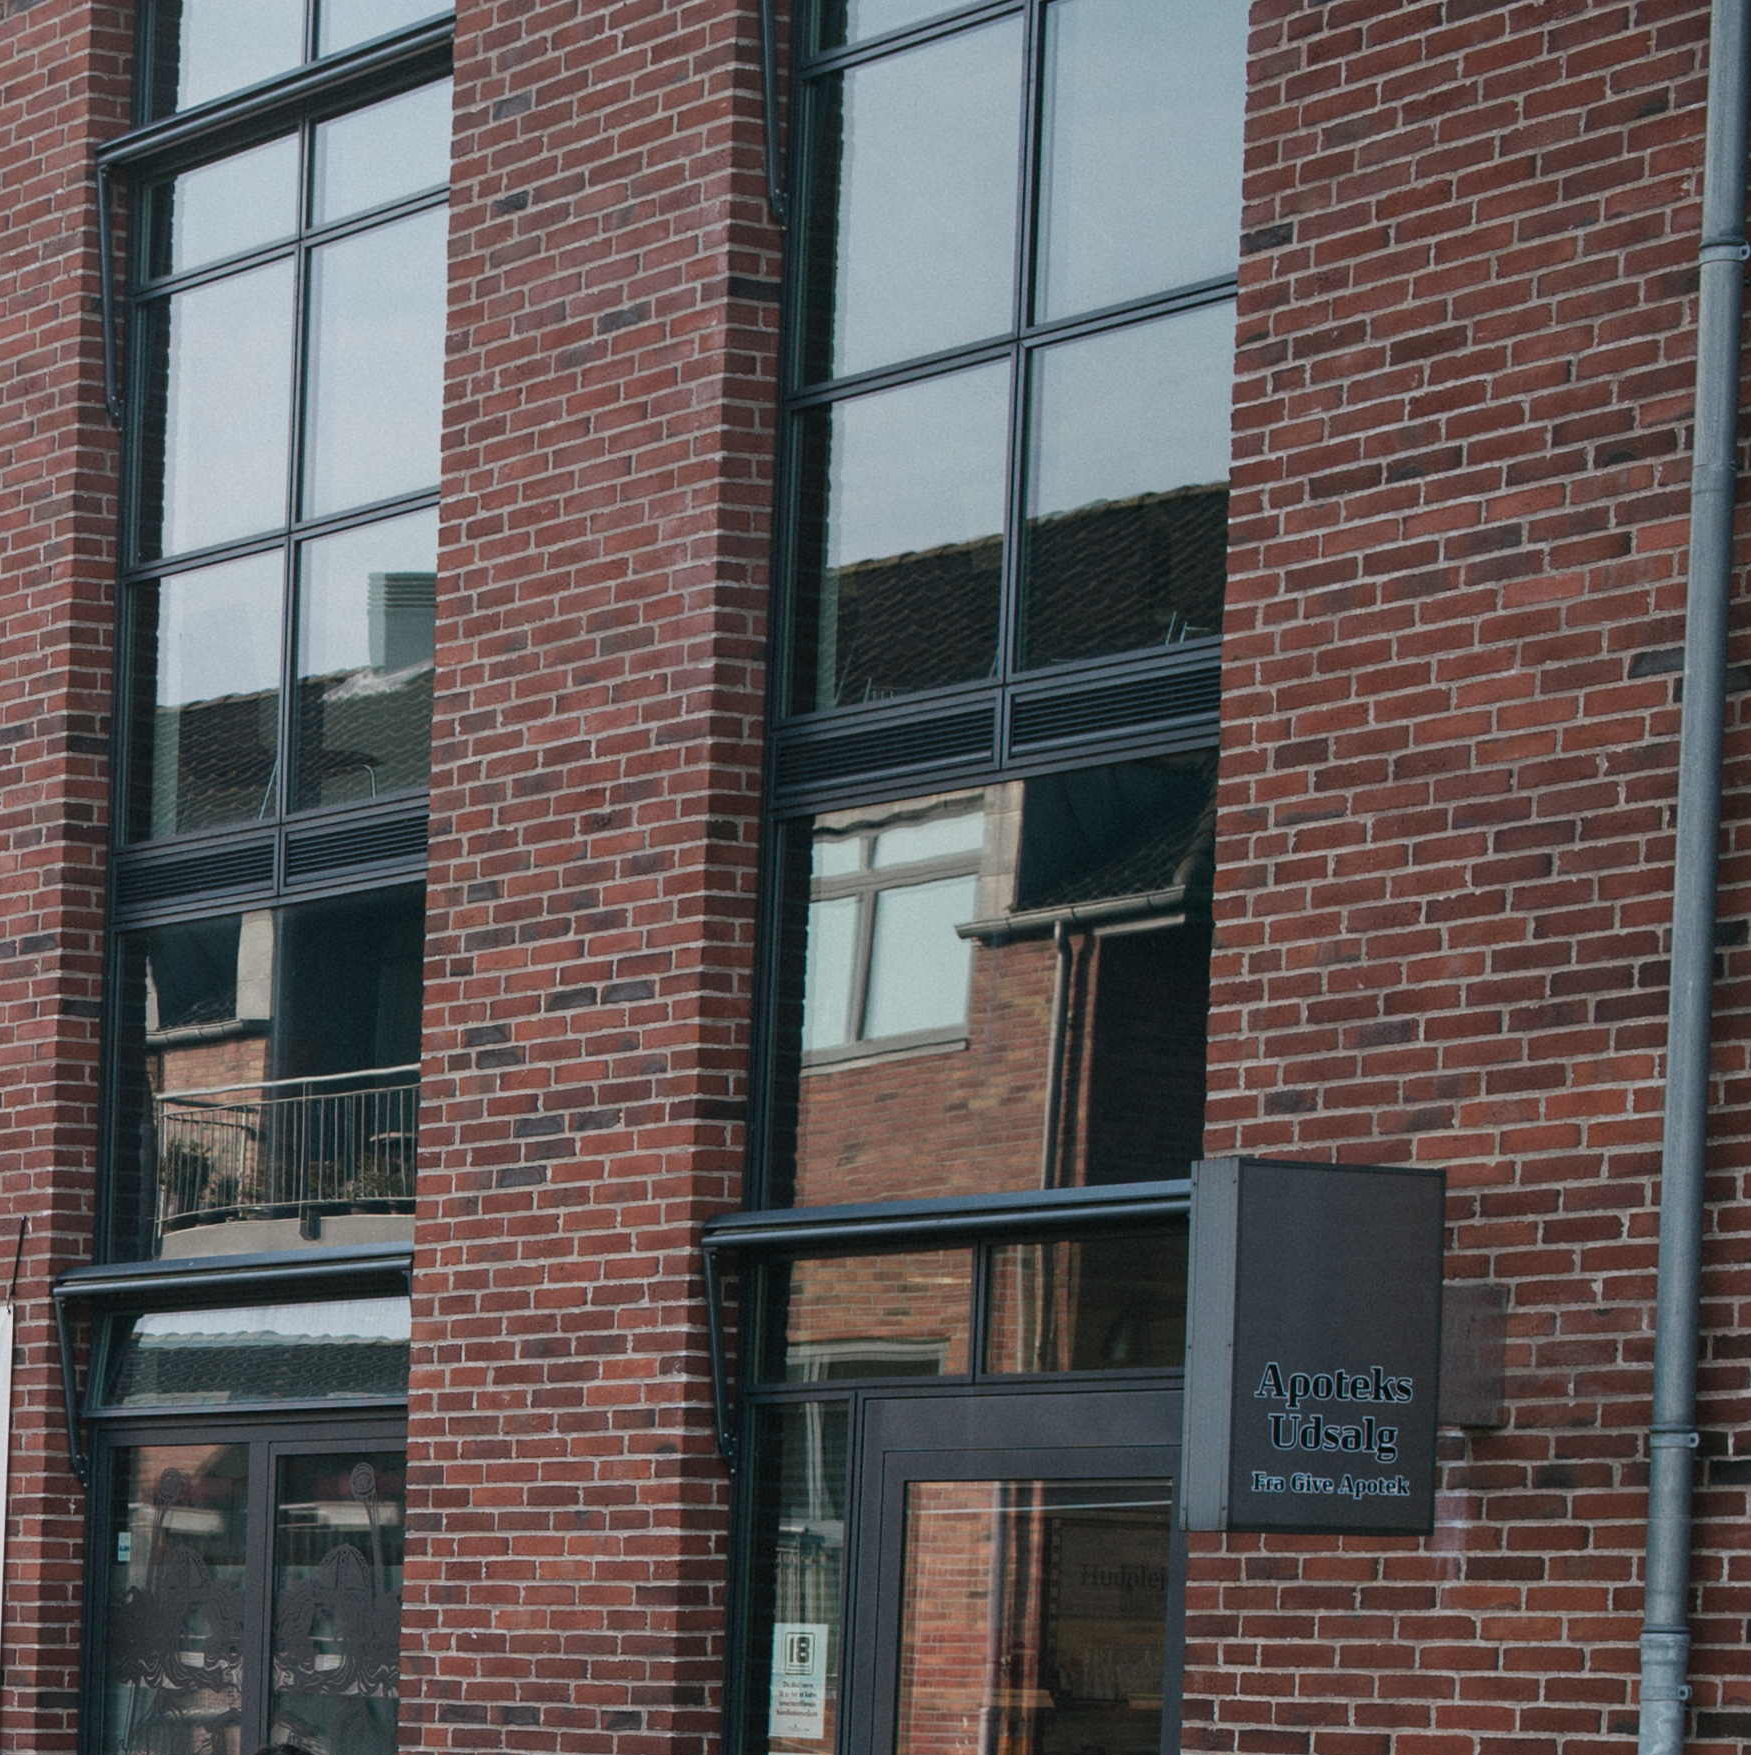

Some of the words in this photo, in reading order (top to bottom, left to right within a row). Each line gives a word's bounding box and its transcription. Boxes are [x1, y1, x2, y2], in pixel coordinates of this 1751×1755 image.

[1254, 1362, 1413, 1408] Apoteks
[1269, 1413, 1397, 1463] Udsalg
[1252, 1471, 1284, 1493] Fra
[1290, 1472, 1333, 1494] Give
[1338, 1474, 1409, 1499] Apotek
[789, 1636, 810, 1663] 18
